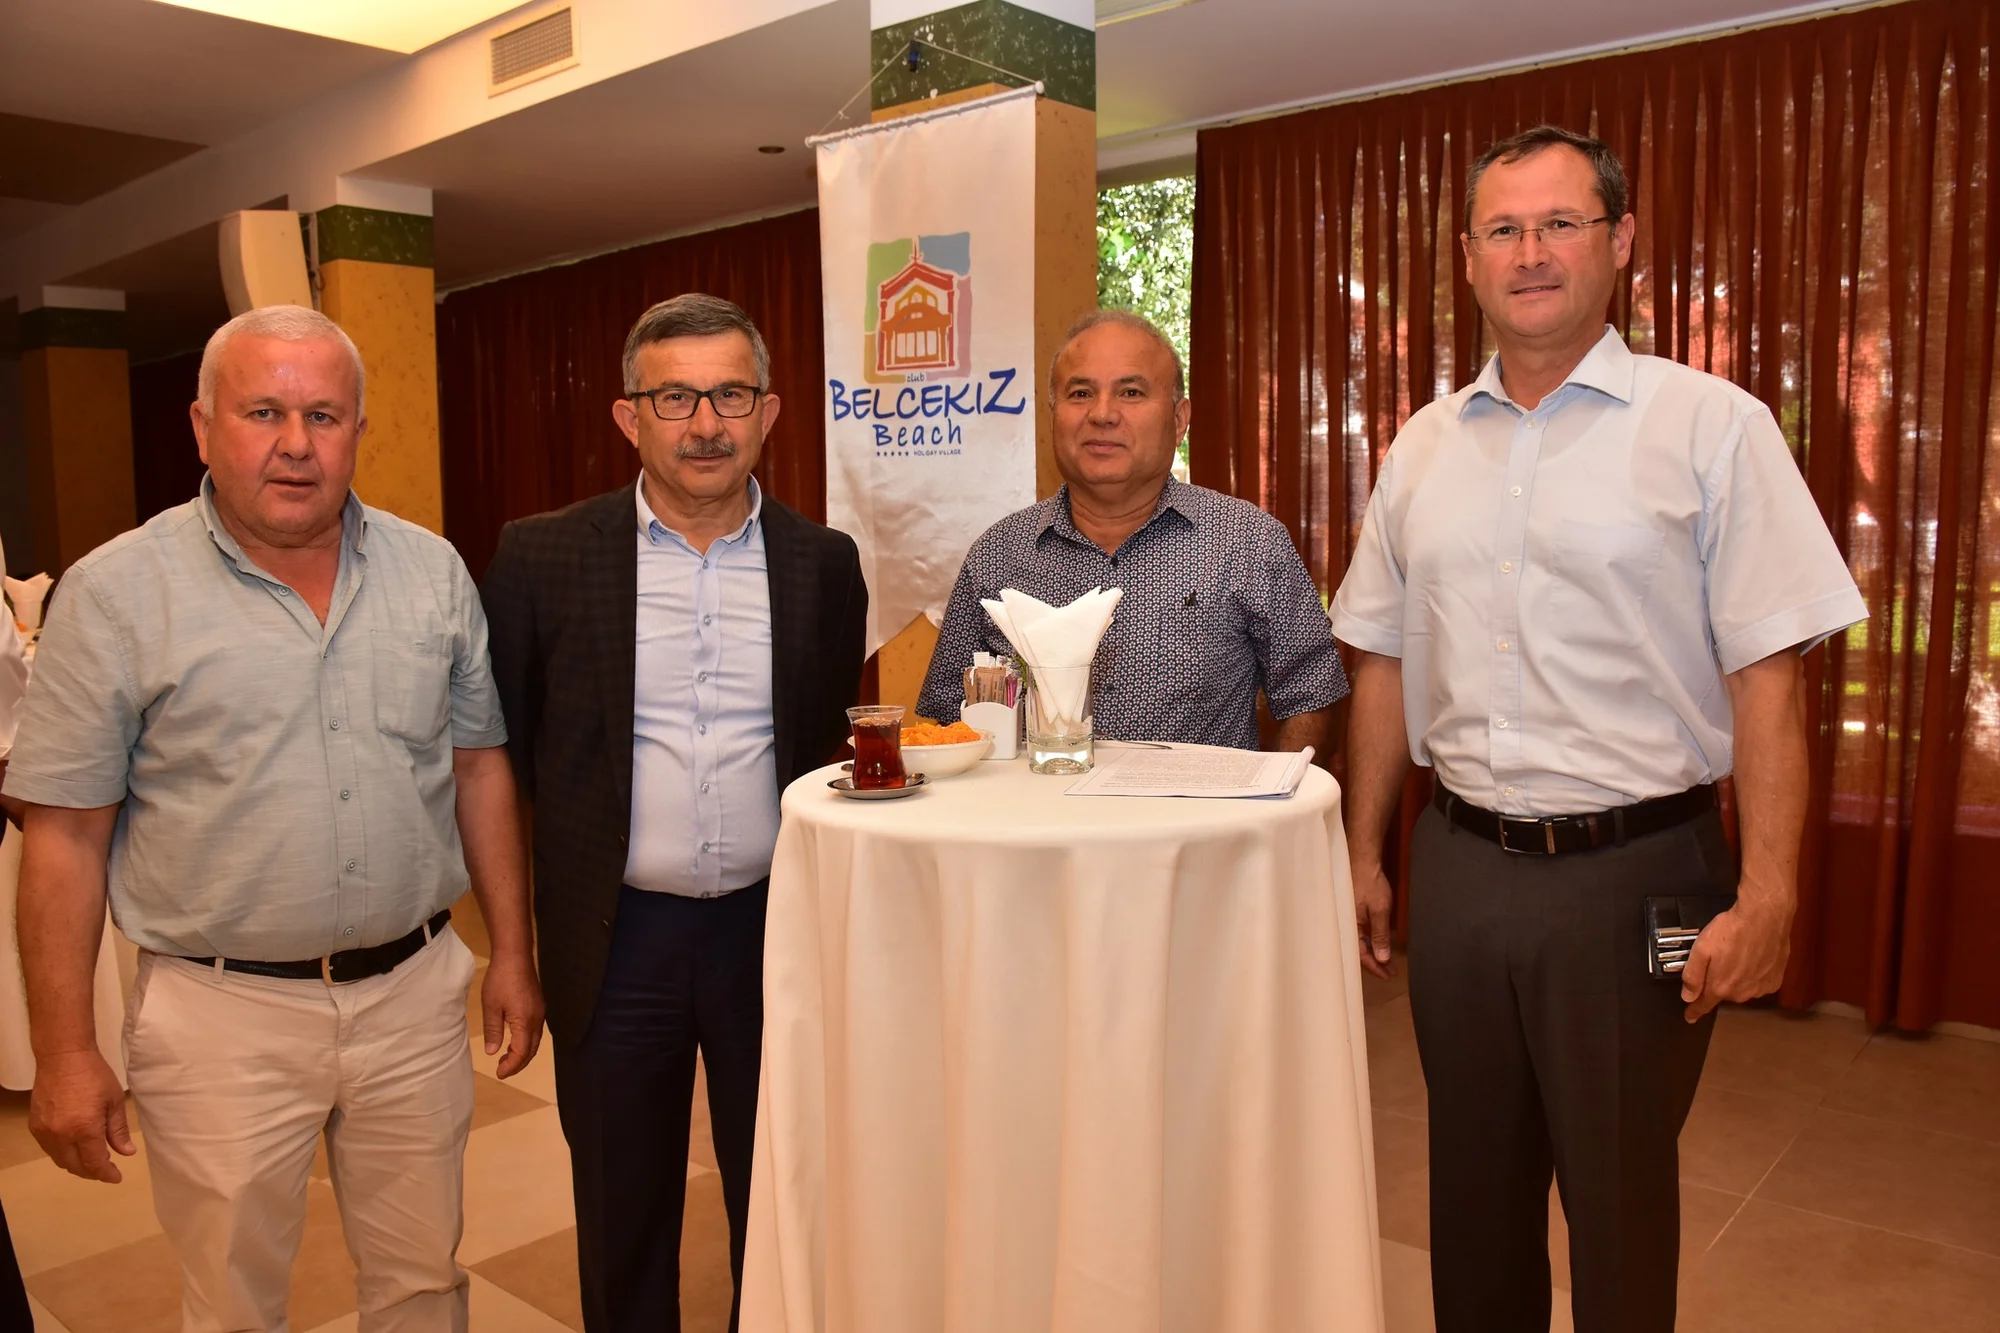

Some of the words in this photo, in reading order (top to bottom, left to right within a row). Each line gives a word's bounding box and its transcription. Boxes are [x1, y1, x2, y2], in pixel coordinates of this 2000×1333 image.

[906, 372, 925, 383] club
[829, 368, 1026, 421] BELCEKIZ
[872, 418, 962, 447] Beach
